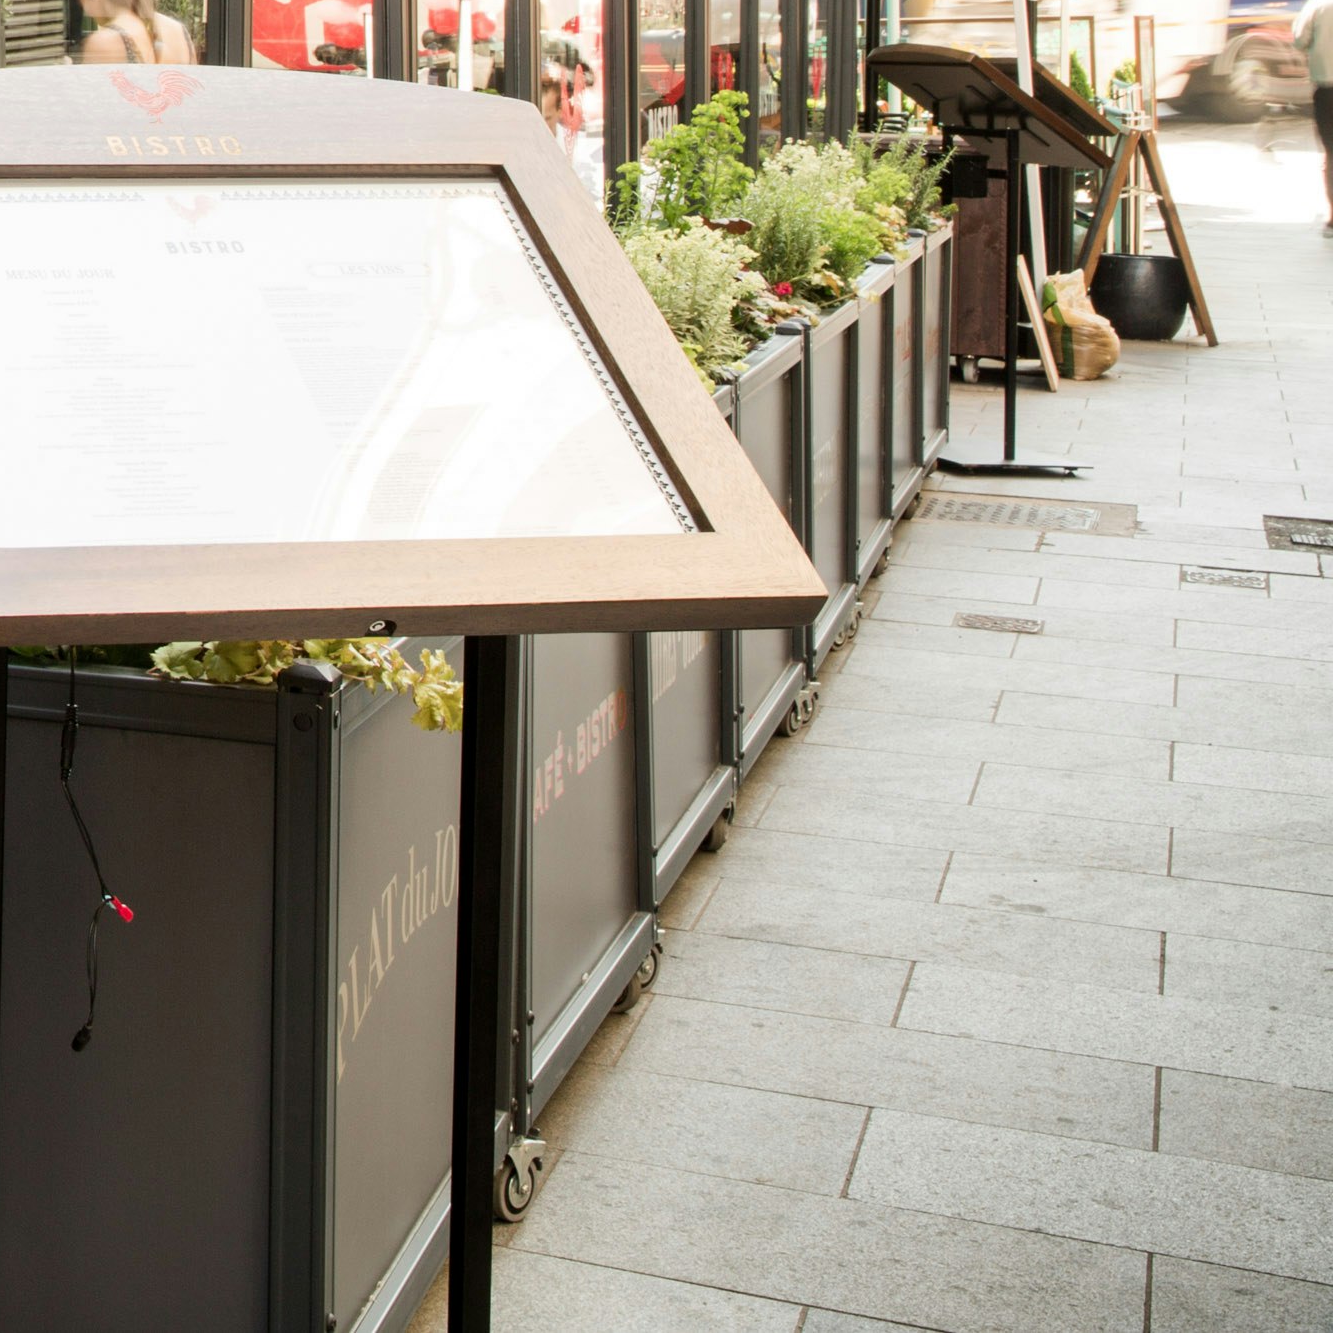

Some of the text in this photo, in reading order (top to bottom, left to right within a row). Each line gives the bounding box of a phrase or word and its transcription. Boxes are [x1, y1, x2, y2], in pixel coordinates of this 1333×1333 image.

[105, 135, 243, 156] BISTRO
[165, 240, 245, 255] BISTRO
[534, 685, 627, 824] AFÉ BISTRO
[337, 824, 456, 1085] PLAT du JO
